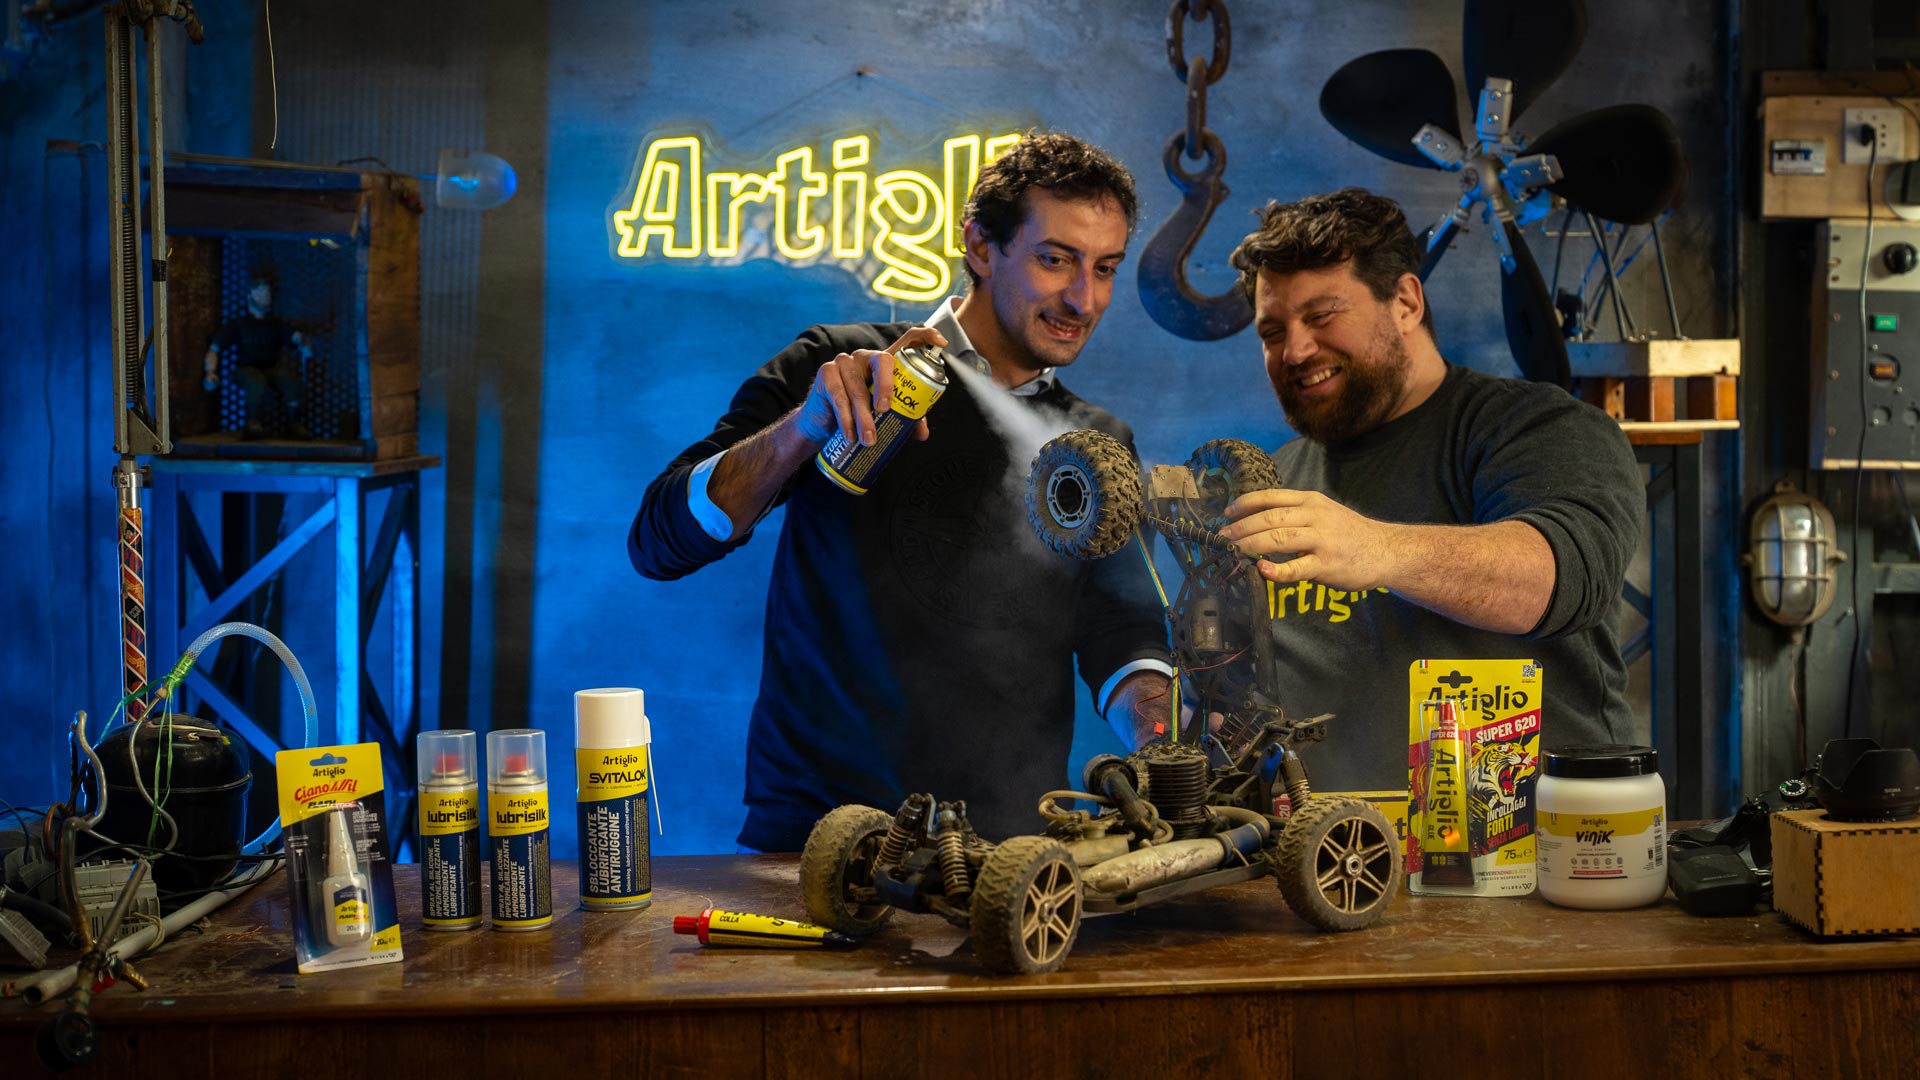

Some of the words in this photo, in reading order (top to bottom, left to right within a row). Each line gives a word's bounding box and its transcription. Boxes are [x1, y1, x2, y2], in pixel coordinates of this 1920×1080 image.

[613, 134, 1021, 301] Artigl
[1423, 685, 1528, 721] Artiglio
[1476, 722, 1513, 744] SUPER
[1514, 714, 1536, 732] 620
[313, 766, 346, 778] Artiglio
[603, 755, 638, 767] Artiglio
[589, 769, 646, 783] SVITALOK
[439, 798, 469, 808] Artiglio
[508, 798, 538, 809] Artiglio
[1429, 748, 1459, 839] Artiglio
[428, 808, 477, 822] lubrisilk
[497, 808, 546, 823] lubrisilk
[1486, 796, 1526, 822] INCOLLAGGI
[1581, 818, 1608, 827] Artiglio
[1486, 813, 1514, 838] FORTI
[1487, 832, 1507, 849] SENZA
[1508, 822, 1529, 840] LIMITI
[588, 812, 598, 893] SBLOCCANTE
[597, 806, 610, 893] LUBRIFICANTE
[609, 812, 621, 893] ANTIRUGGINE
[449, 865, 458, 916] LUBRIFICANTE
[510, 861, 519, 918] AMMORBIDENTE
[518, 866, 526, 918] LUBRIFICANTE
